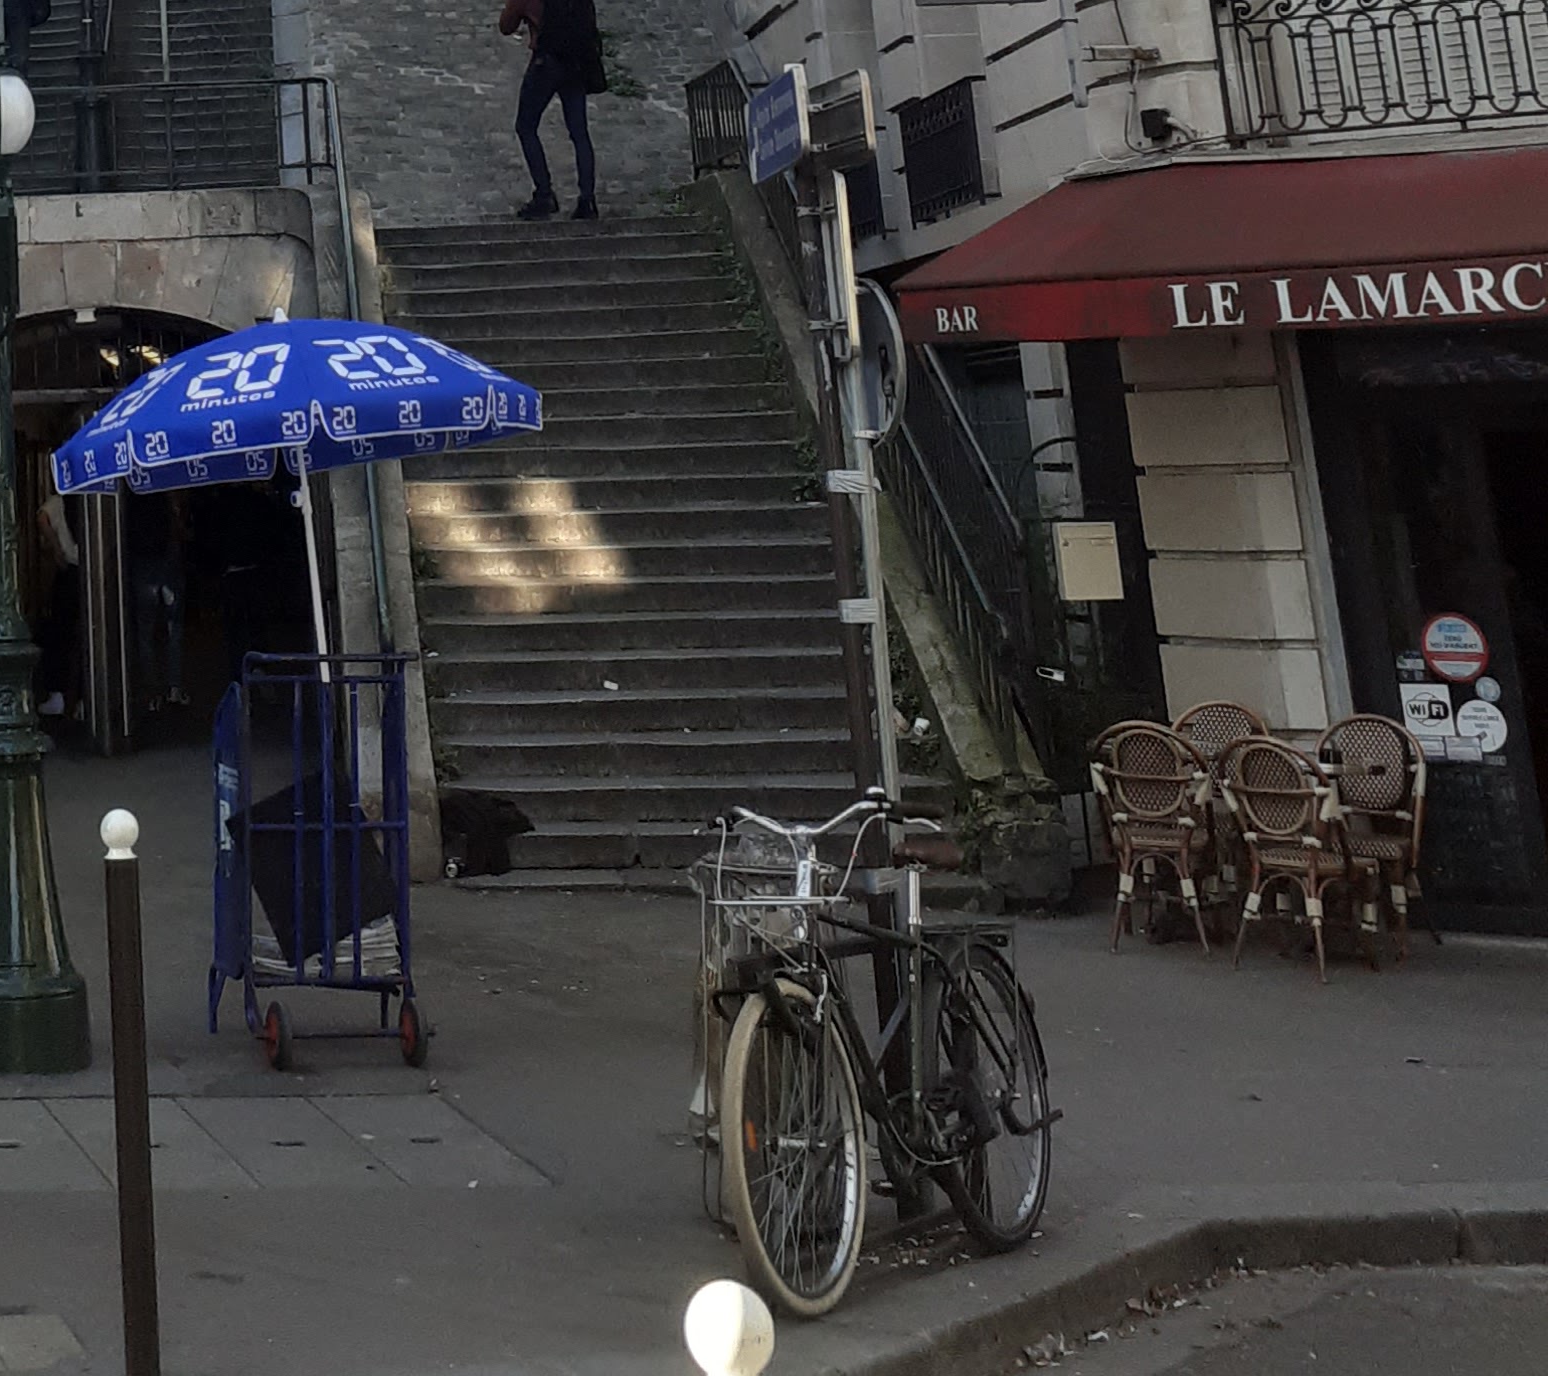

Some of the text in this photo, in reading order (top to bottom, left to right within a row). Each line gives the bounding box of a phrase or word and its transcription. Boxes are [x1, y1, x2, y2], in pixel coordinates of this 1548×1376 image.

[1167, 262, 1548, 329] LE LAMARC
[935, 305, 979, 334] BAR
[186, 342, 291, 400] 20
[313, 335, 428, 380] 20
[348, 375, 440, 391] minutes
[180, 391, 276, 412] minutes
[332, 397, 484, 430] 20 20 20
[144, 410, 307, 457] 20 20 20
[114, 441, 127, 466] 20
